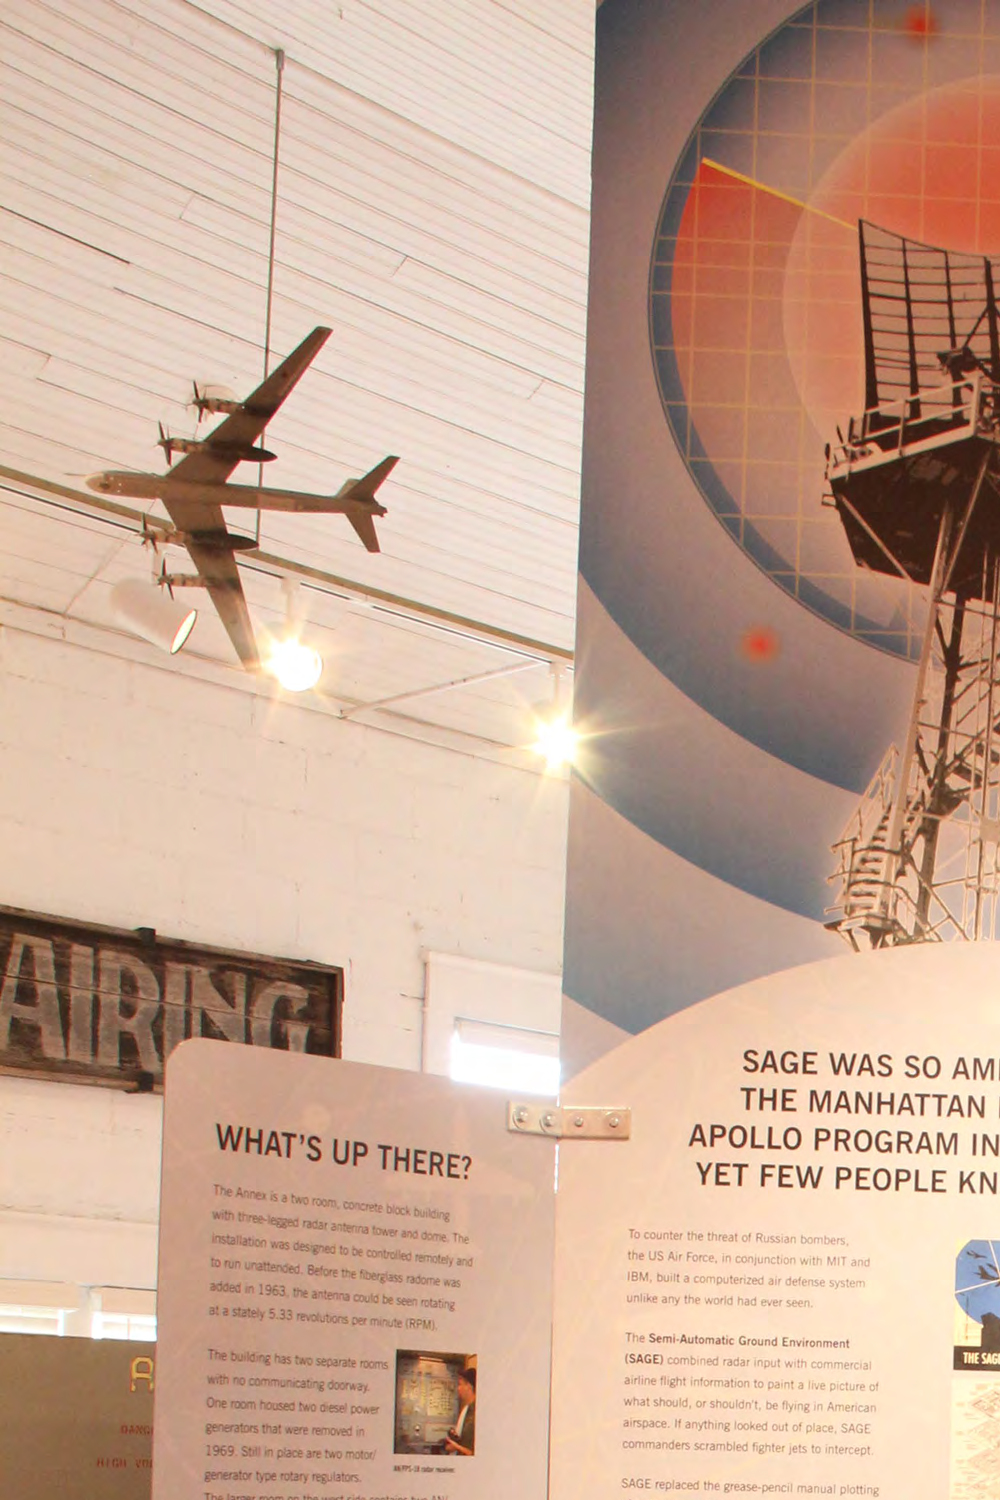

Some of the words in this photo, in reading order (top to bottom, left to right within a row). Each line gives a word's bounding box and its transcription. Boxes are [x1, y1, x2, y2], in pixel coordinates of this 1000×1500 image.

[743, 1049, 817, 1075] SAGE
[829, 1052, 892, 1077] WAS
[904, 1055, 941, 1079] SO
[740, 1087, 797, 1112] THE
[809, 1089, 985, 1118] MANHATTAN
[688, 1123, 801, 1150] APOLLO
[814, 1128, 958, 1155] PROGRAM
[972, 1133, 999, 1156] IN
[216, 1123, 321, 1162] WHAT'S
[333, 1138, 368, 1166] UP
[377, 1144, 471, 1179] THERE?
[696, 1161, 748, 1186] YET
[760, 1164, 823, 1189] FEW
[835, 1166, 946, 1193] PEOPLE
[213, 1183, 233, 1197] The
[234, 1186, 267, 1200] Annex
[269, 1190, 278, 1202] is
[281, 1194, 287, 1203] a
[290, 1193, 309, 1205] two
[342, 1200, 383, 1213] concrete
[386, 1203, 411, 1216] block
[413, 1206, 450, 1223] building
[628, 1228, 640, 1239] To
[643, 1230, 683, 1240] counter
[687, 1231, 703, 1241] the
[707, 1231, 738, 1242] threat
[741, 1232, 751, 1242] of
[755, 1232, 796, 1244] Russian
[800, 1234, 848, 1246] bombers,
[627, 1249, 644, 1260] the
[648, 1250, 664, 1261] US
[667, 1251, 682, 1262] Air
[686, 1251, 717, 1264] Force,
[722, 1253, 731, 1263] in
[735, 1254, 796, 1266] conjunction
[799, 1255, 822, 1266] with
[827, 1255, 846, 1266] MIT
[850, 1258, 870, 1267] and
[626, 1292, 658, 1303] unlike
[661, 1295, 680, 1306] any
[684, 1293, 700, 1305] the
[704, 1295, 733, 1305] world
[737, 1296, 756, 1306] had
[760, 1298, 782, 1307] ever
[786, 1299, 813, 1308] seen.
[209, 1305, 219, 1315] at
[222, 1307, 229, 1316] a
[232, 1306, 265, 1321] stately
[269, 1307, 293, 1321] 5.33
[296, 1312, 349, 1324] revolutions
[351, 1316, 367, 1326] per
[369, 1318, 402, 1328] minute
[625, 1332, 645, 1343] The
[648, 1332, 734, 1345] Semi-Automatic
[738, 1335, 777, 1346] Ground
[782, 1336, 849, 1348] Environment
[624, 1353, 664, 1365] (SAGE)
[667, 1355, 719, 1366] combined
[722, 1357, 750, 1367] radar
[753, 1358, 780, 1369] input
[784, 1358, 807, 1368] with
[810, 1361, 871, 1370] commercial
[963, 1352, 979, 1364] THE
[120, 1424, 153, 1435] DANG
[96, 1457, 127, 1468] HIGH
